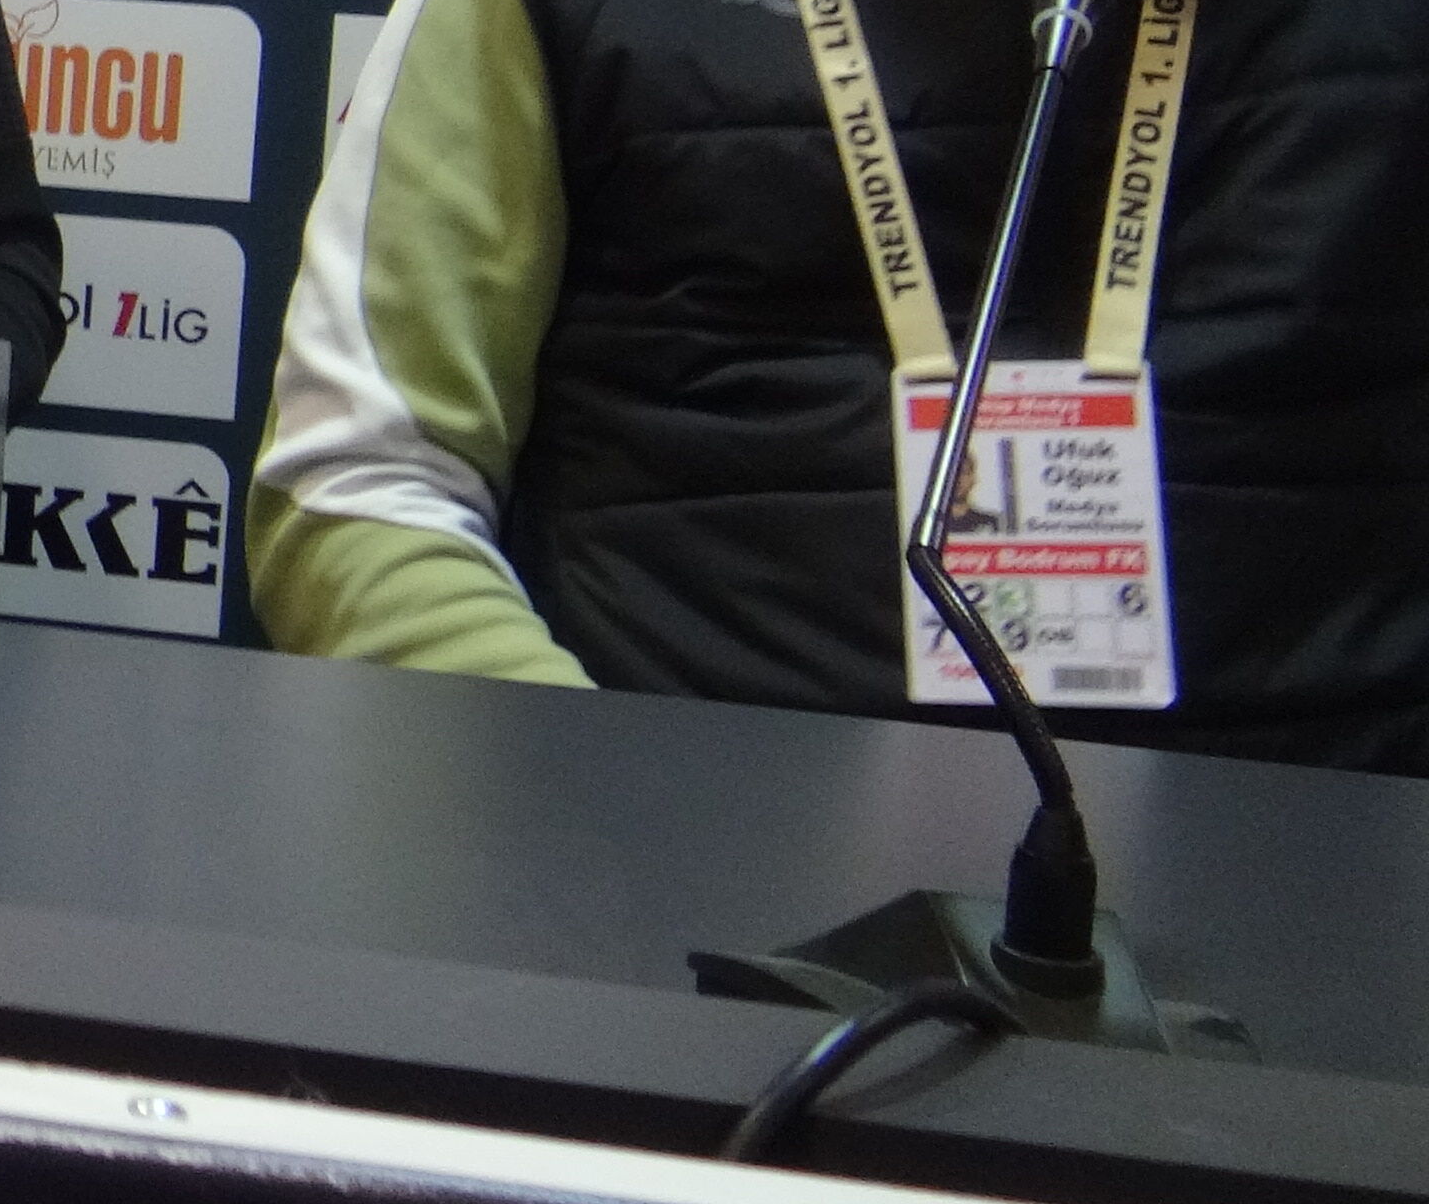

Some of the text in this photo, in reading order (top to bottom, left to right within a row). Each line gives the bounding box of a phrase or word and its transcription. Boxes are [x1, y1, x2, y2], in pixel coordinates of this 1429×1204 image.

[831, 58, 863, 89] 1.
[843, 98, 919, 300] TRENDYOL
[1104, 99, 1166, 292] TRENDYOL
[1142, 59, 1174, 88] 1.
[1042, 437, 1115, 461] Ufuk
